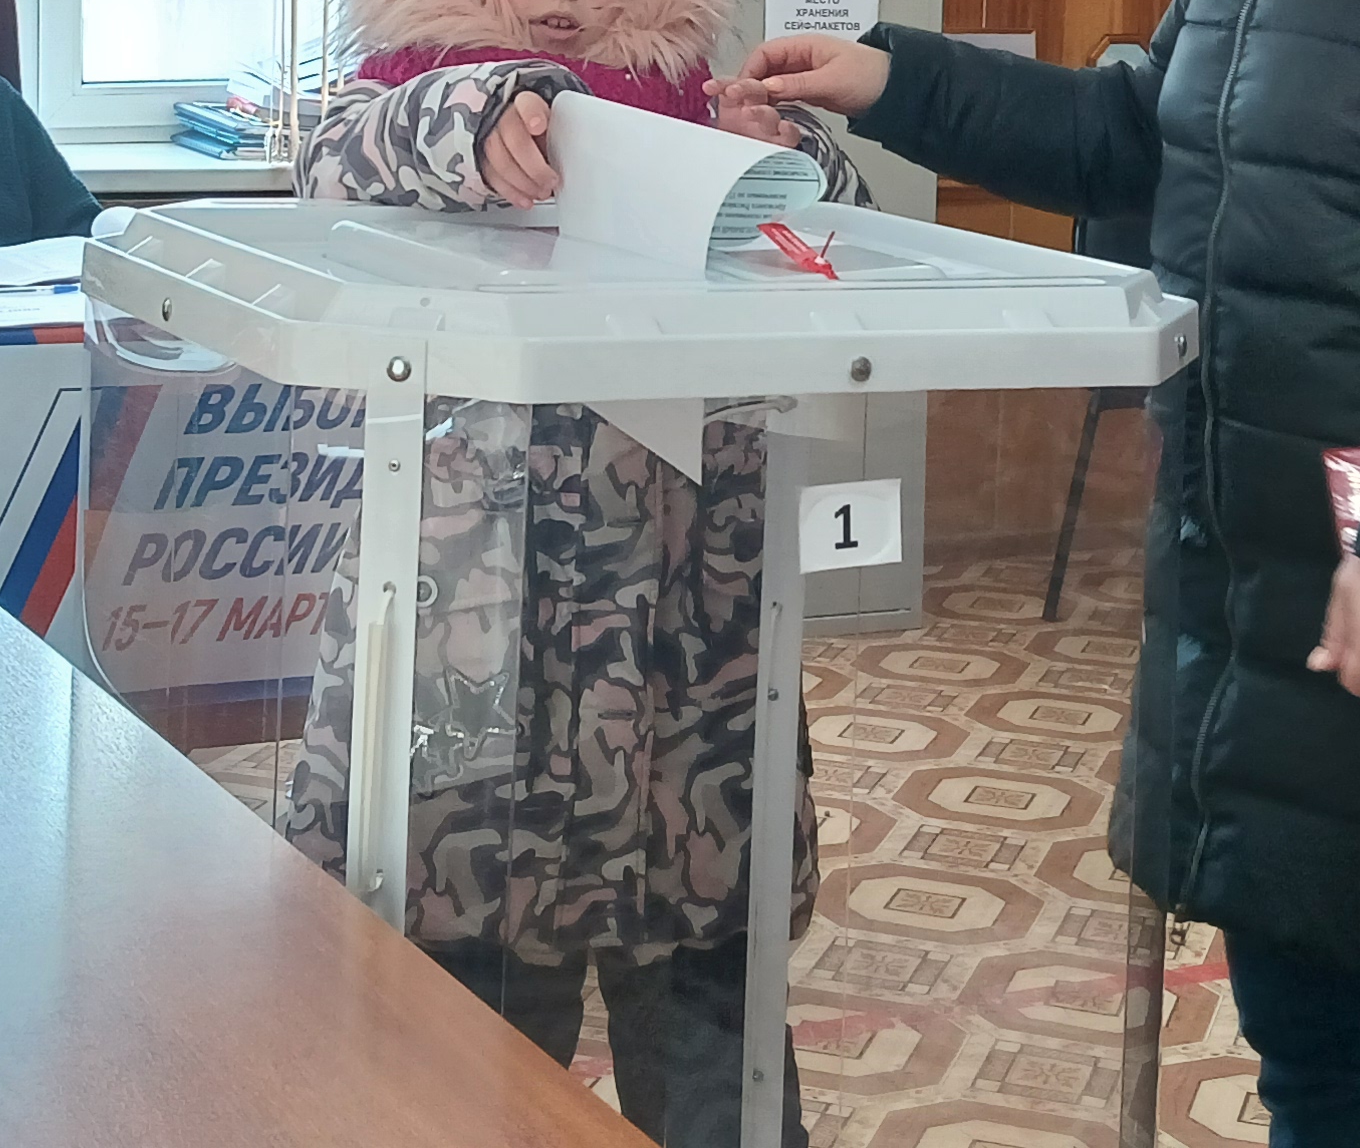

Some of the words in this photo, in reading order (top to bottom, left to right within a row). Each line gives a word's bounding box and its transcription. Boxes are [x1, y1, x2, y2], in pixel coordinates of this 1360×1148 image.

[795, 8, 849, 18] ХРАНЕНИЯ
[784, 20, 861, 31] СЕЙФ-ПАКЕТОВ
[834, 504, 859, 550] 1
